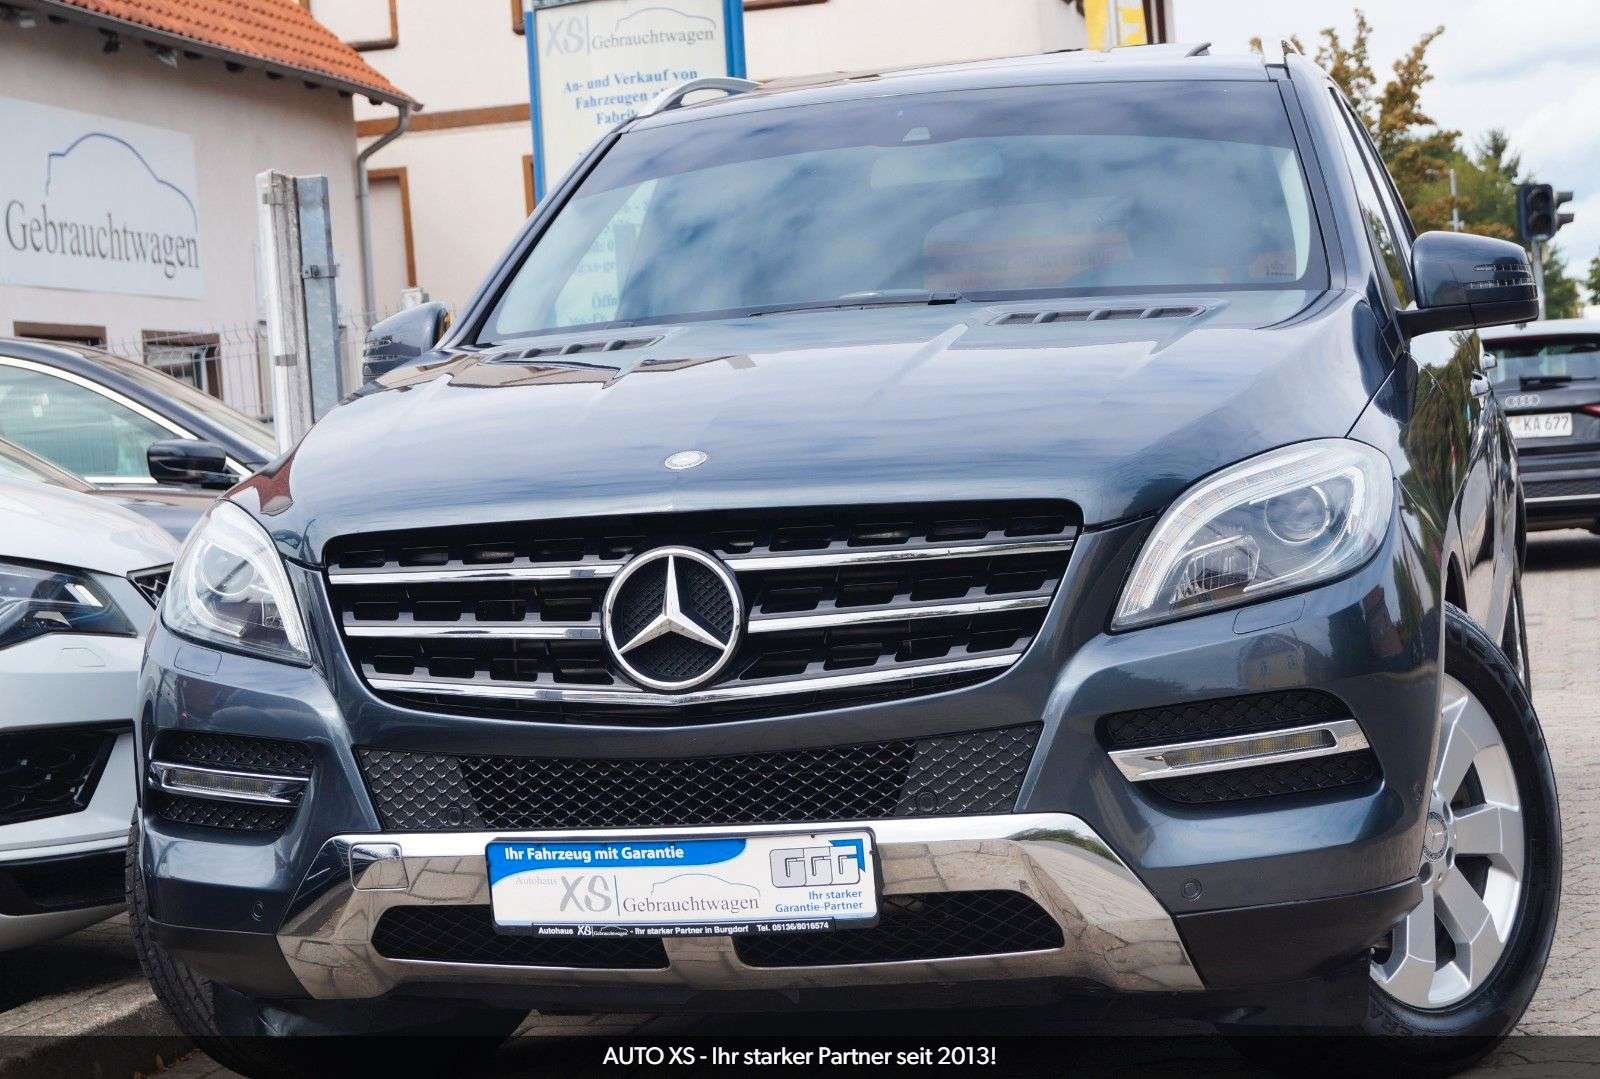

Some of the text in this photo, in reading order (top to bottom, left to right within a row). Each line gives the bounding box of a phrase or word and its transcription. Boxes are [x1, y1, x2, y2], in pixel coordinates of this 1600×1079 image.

[545, 15, 715, 56] XS Gebrauchtwagen
[587, 75, 610, 89] und
[614, 69, 669, 85] Verkauf
[672, 69, 698, 80] von
[575, 91, 648, 109] Fahrzeugen
[5, 200, 199, 279] Gebrauchtwagen
[1545, 414, 1569, 430] 677
[505, 846, 684, 863] Ihr Fahrzeug mit Garantie
[559, 875, 760, 914] XS Gebrauchtwagen
[808, 889, 863, 900] Ihr starker
[538, 926, 574, 935] Autohaus
[577, 925, 592, 936] XS
[647, 926, 672, 934] starker
[675, 925, 703, 934] Partner
[705, 925, 713, 933] in
[715, 924, 749, 935] Burgdorf
[757, 923, 771, 932] Tel.
